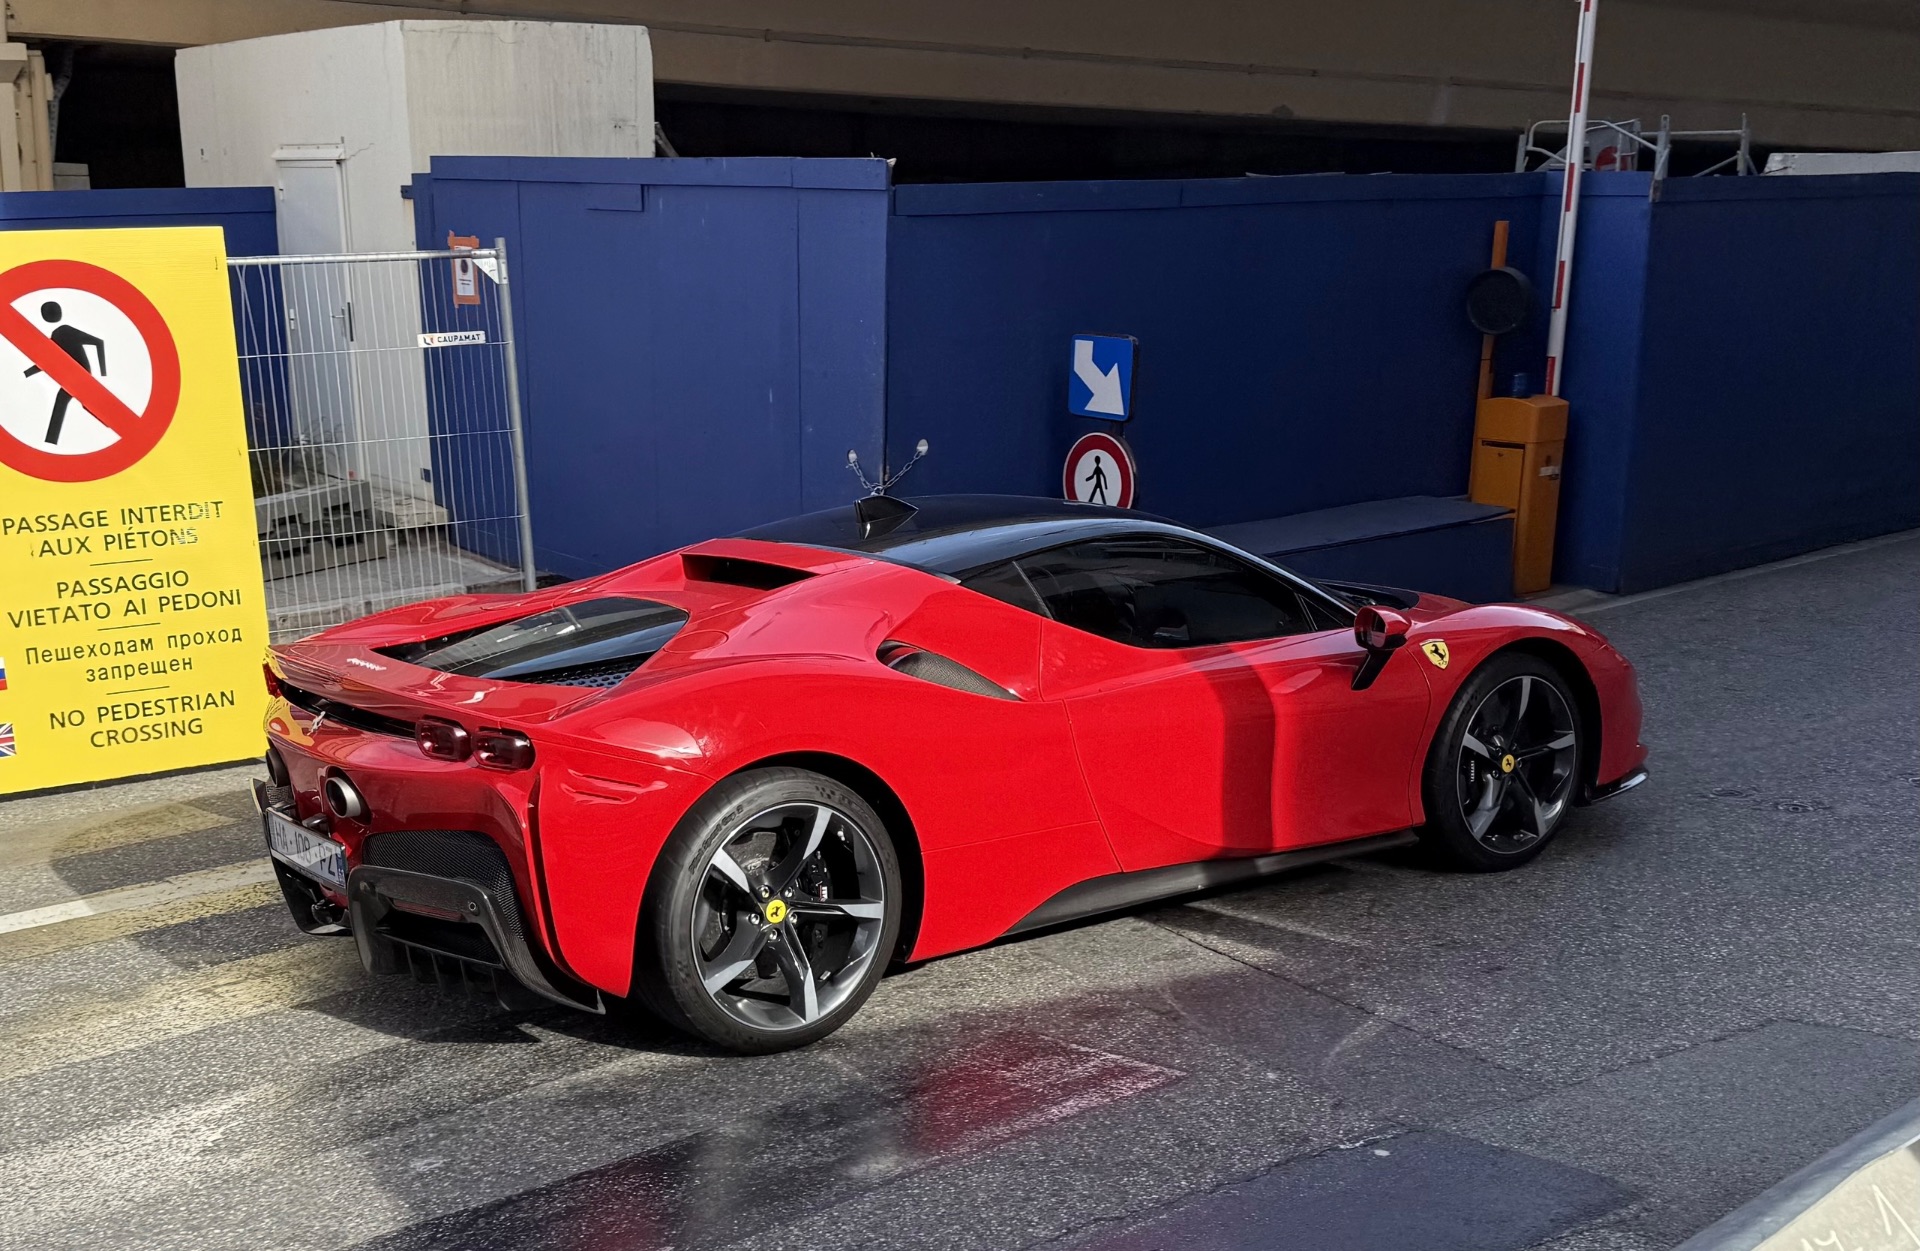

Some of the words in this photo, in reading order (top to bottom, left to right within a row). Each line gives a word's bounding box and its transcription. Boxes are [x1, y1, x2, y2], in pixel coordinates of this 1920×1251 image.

[437, 333, 481, 343] CAUPAMAT
[2, 510, 109, 535] PASSAGE
[120, 500, 224, 526] INTERDIT
[38, 536, 92, 557] AUX
[103, 526, 198, 551] PIÉTONS
[56, 570, 189, 599] PASSAGGIO
[7, 602, 111, 628] VIETATO
[123, 598, 147, 617] AI
[158, 588, 241, 613] PEDONI
[25, 637, 154, 665] Пешеходам
[167, 628, 243, 650] проход
[86, 657, 193, 683] запрещен
[49, 709, 86, 730] NO
[97, 689, 235, 724] PEDESTRIAN
[90, 717, 203, 748] CROSSING
